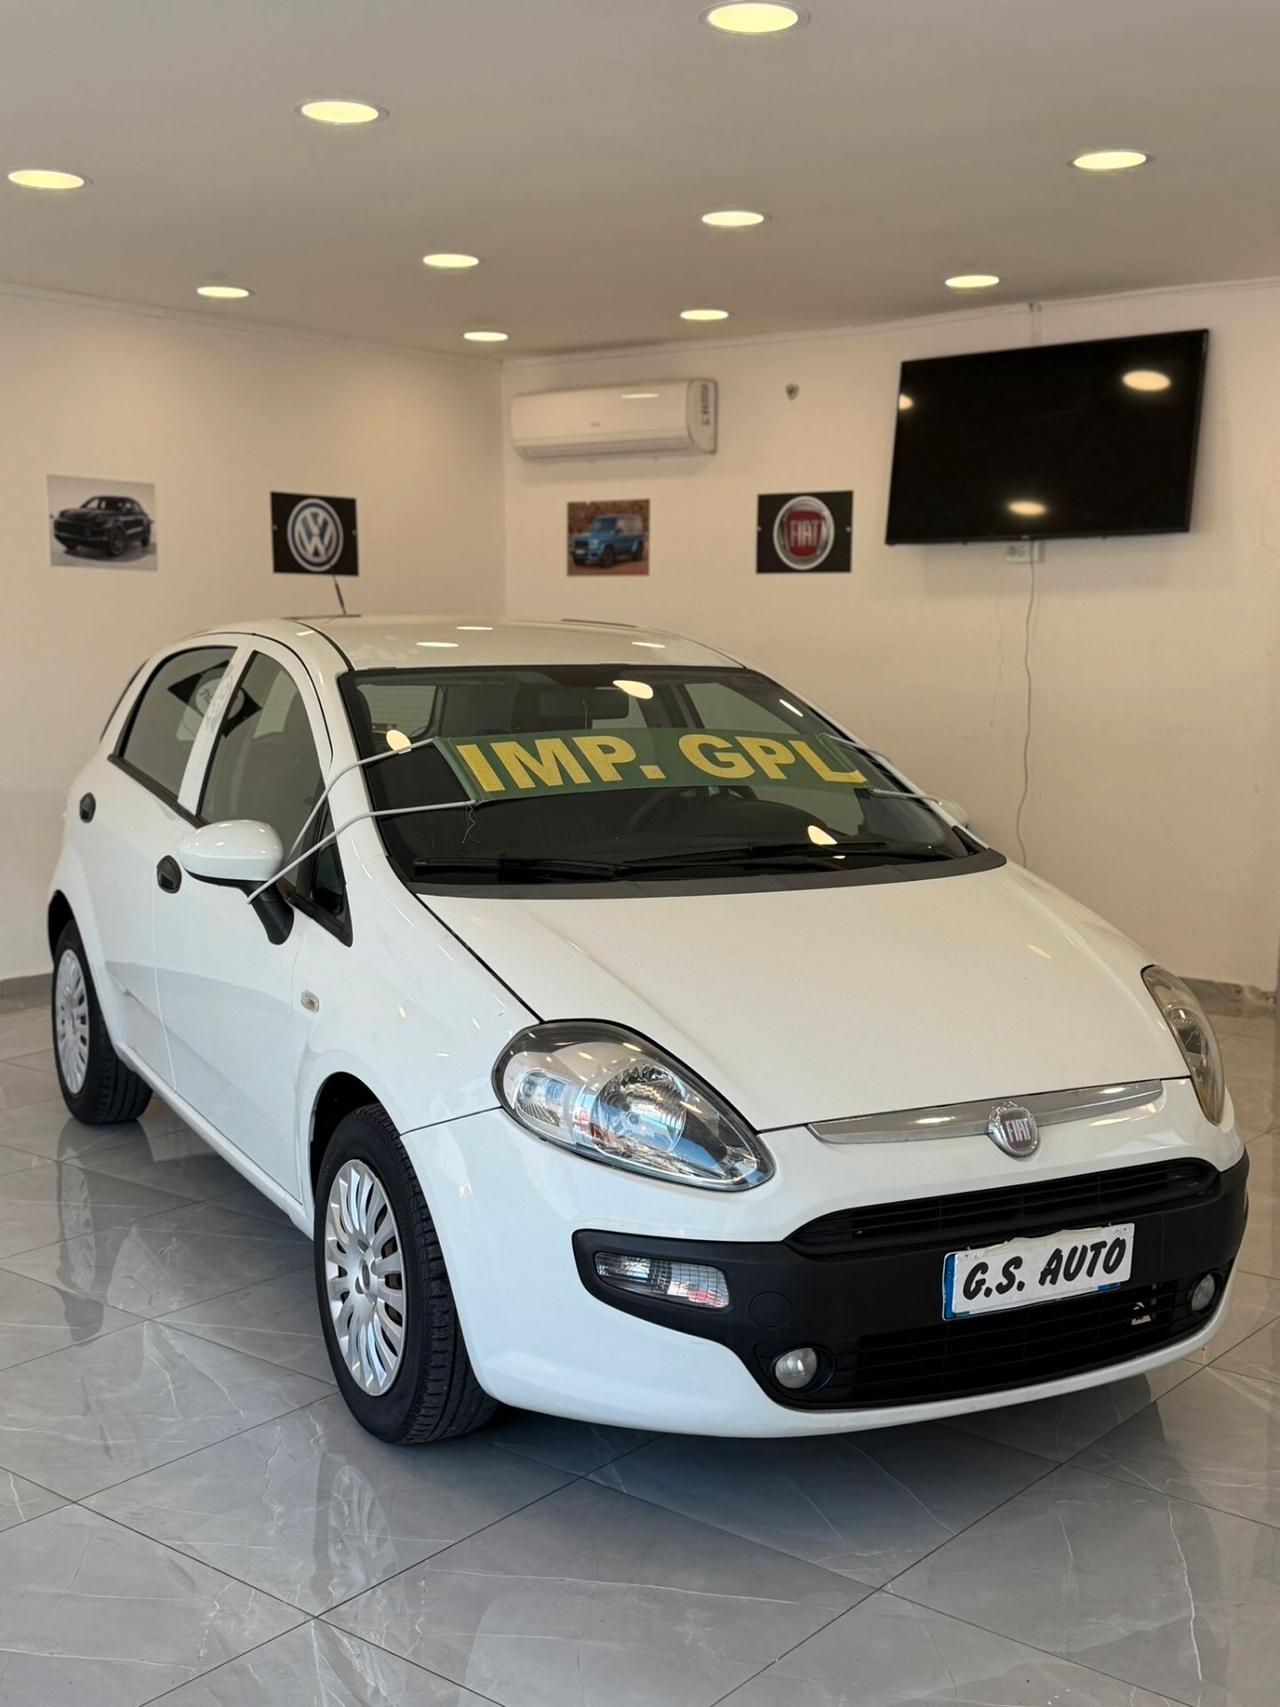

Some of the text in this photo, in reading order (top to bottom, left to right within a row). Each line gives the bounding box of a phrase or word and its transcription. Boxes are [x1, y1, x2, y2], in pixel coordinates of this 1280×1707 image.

[790, 519, 820, 547] FIAT
[456, 734, 868, 792] IMP. GPL
[1005, 1118, 1031, 1142] FIAT
[962, 1236, 1127, 1301] G.S. AUTO
